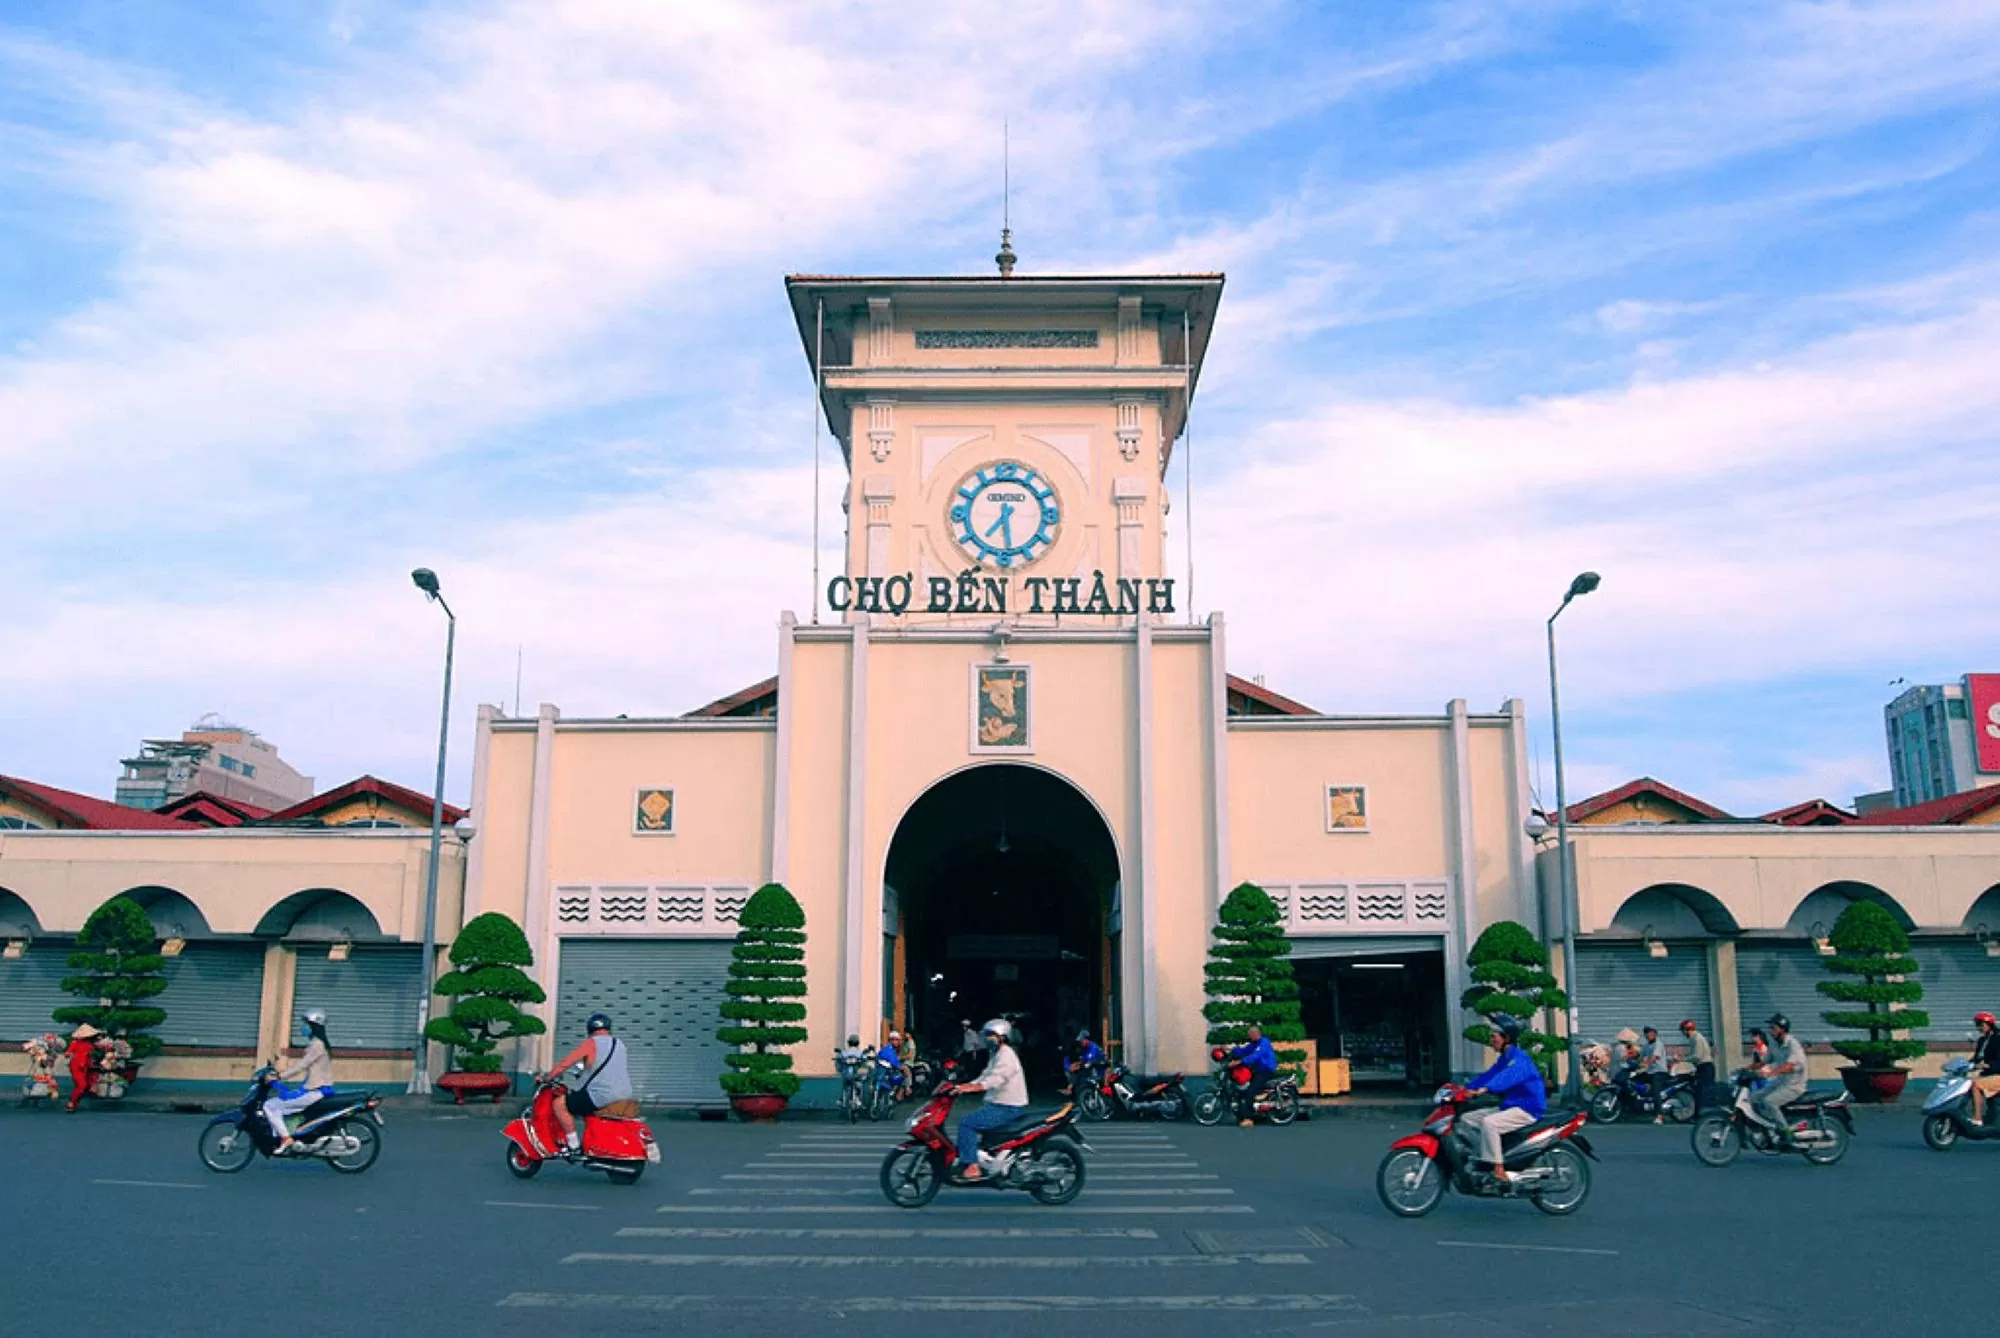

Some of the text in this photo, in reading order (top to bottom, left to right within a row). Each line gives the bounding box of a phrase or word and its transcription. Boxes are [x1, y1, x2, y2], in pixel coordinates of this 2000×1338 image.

[827, 565, 1175, 616] CHỢ BẾN THÀNH
